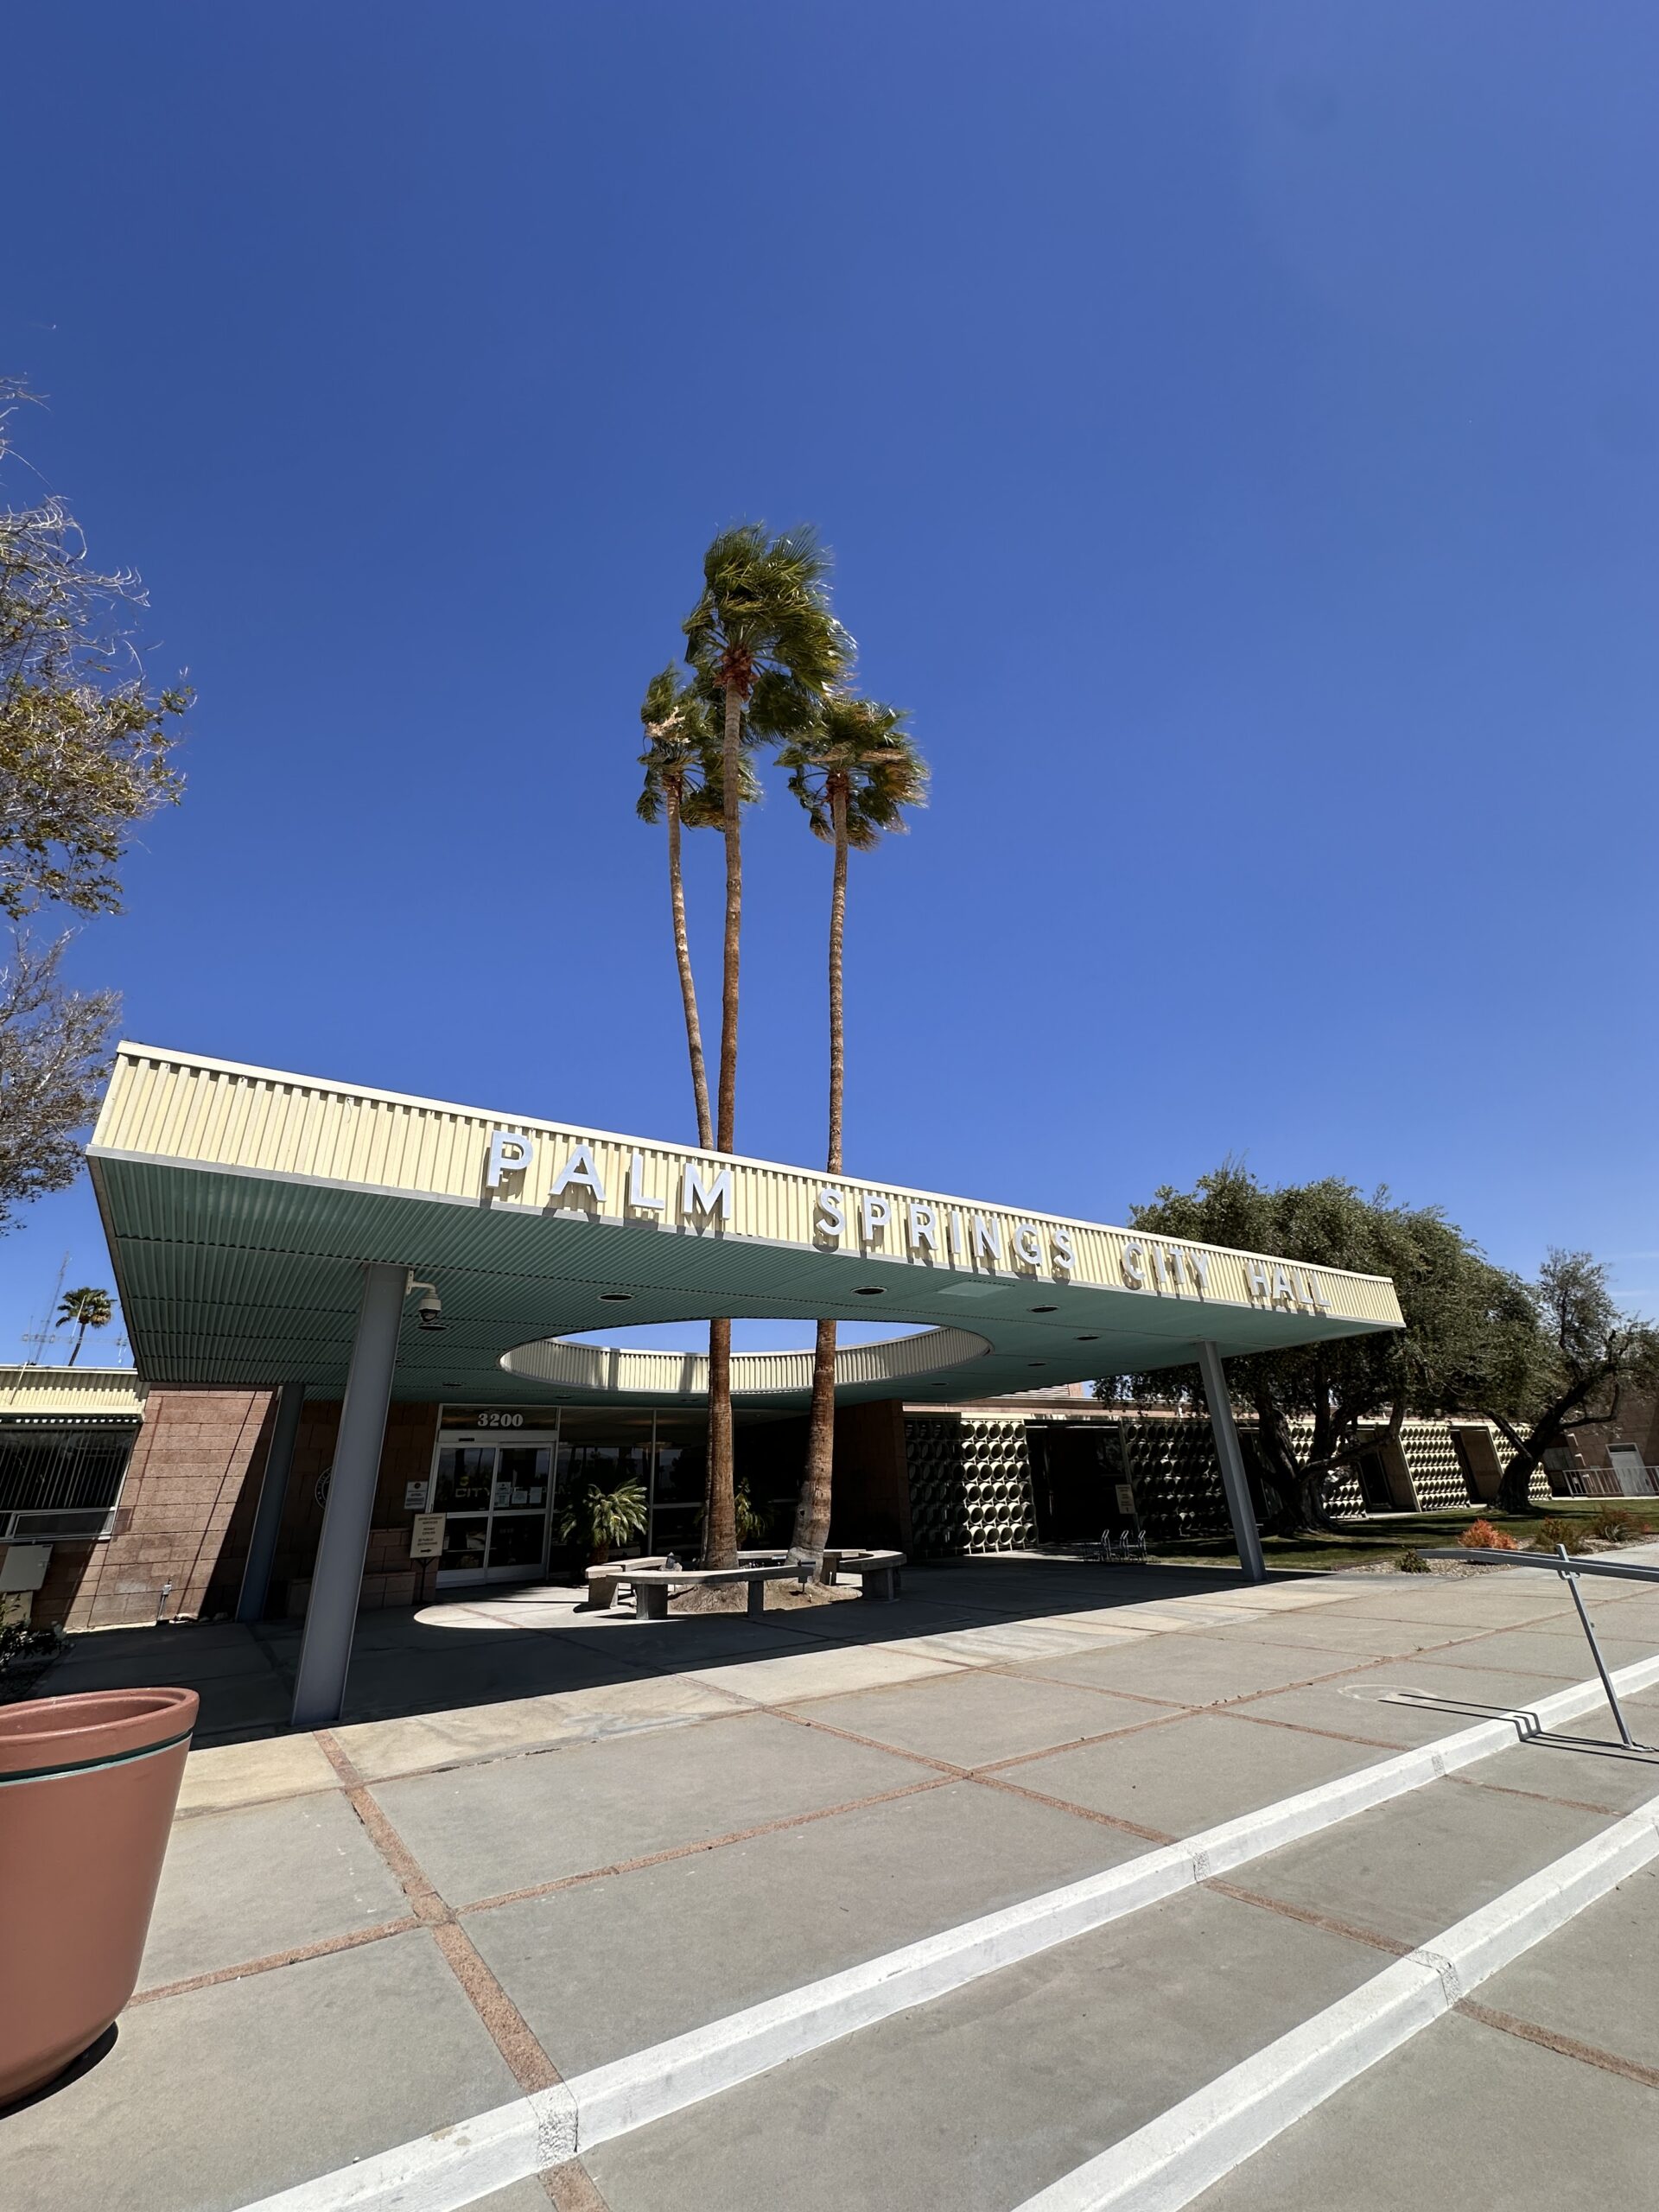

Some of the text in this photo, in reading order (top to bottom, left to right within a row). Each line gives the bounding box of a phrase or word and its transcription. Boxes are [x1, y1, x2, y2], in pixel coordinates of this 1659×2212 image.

[486, 1129, 1332, 1306] PALM SPRINGS CITY HALL
[477, 1413, 524, 1427] 3200
